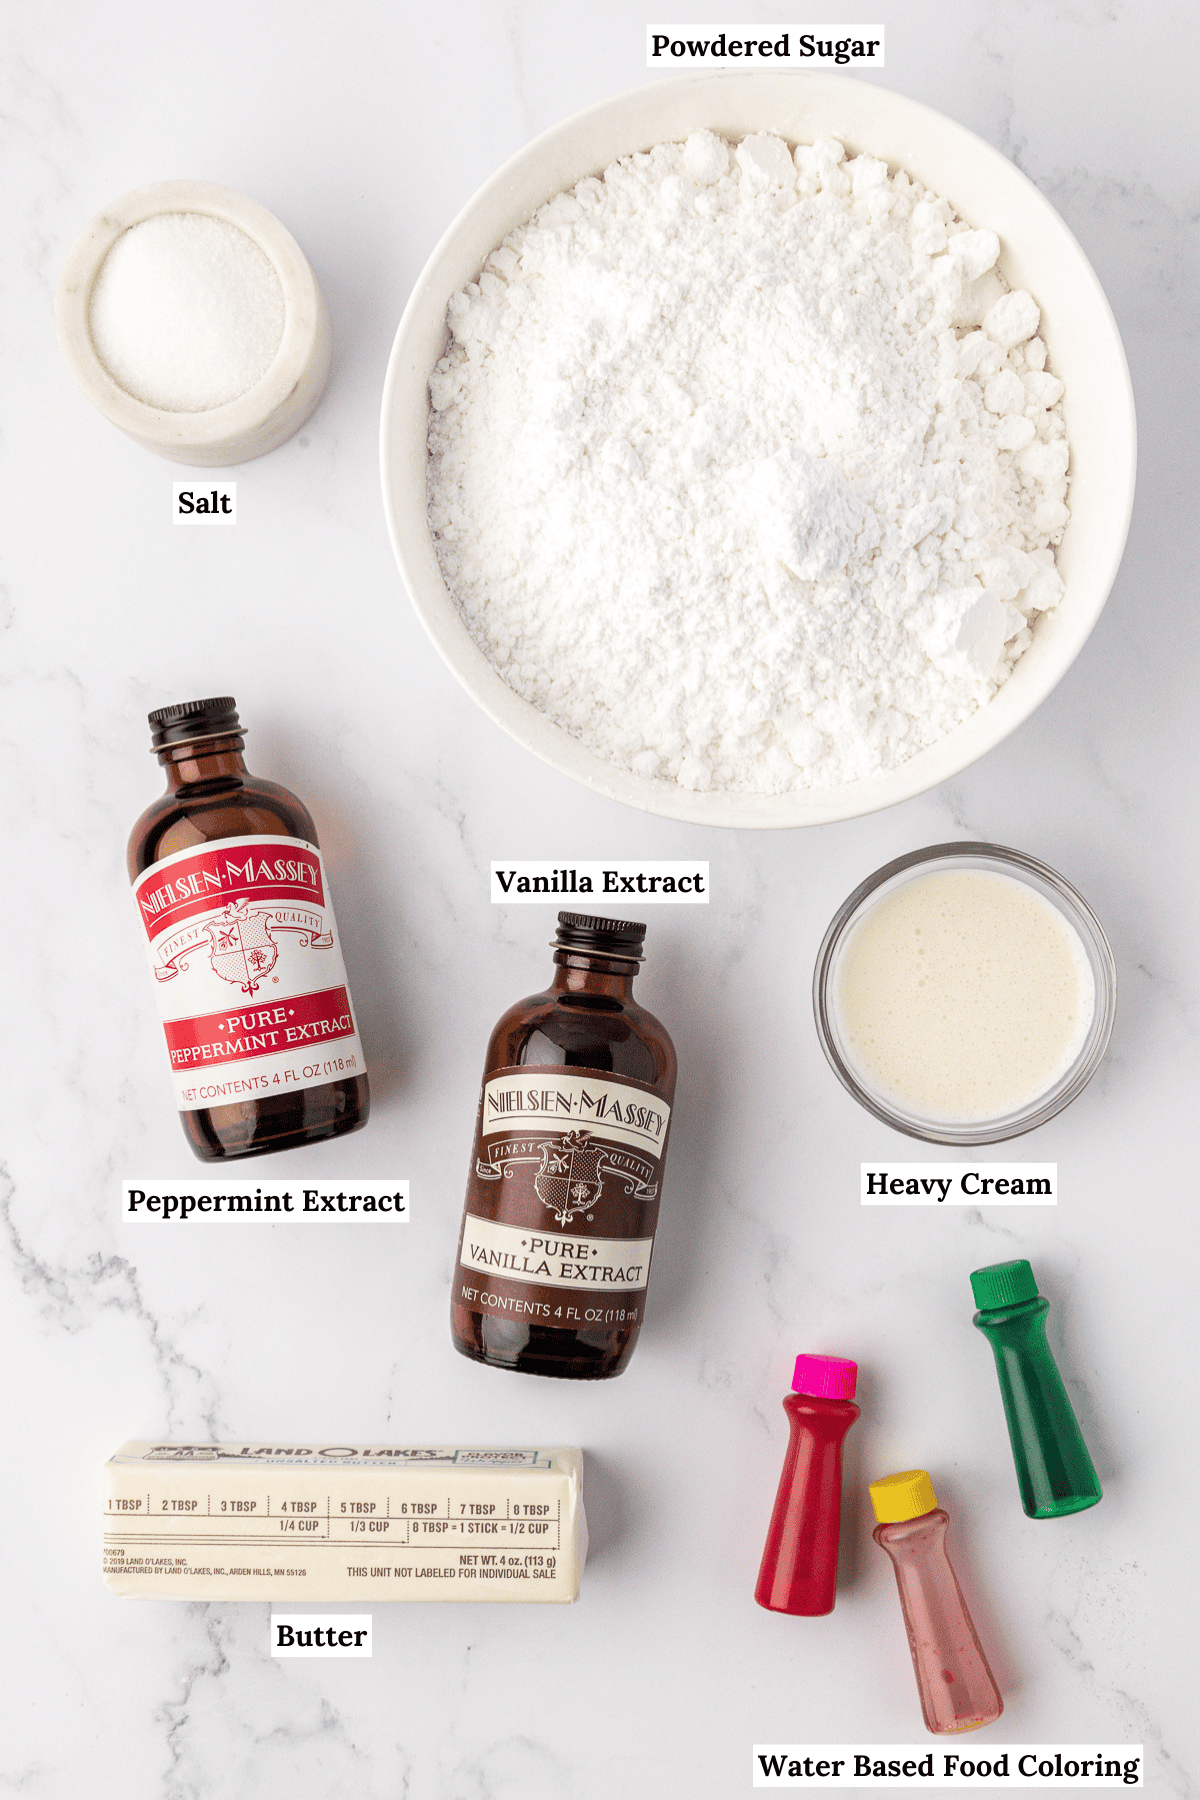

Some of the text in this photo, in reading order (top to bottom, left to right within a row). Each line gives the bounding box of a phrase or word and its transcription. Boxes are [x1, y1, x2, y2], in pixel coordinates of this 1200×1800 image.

[275, 912, 320, 928] QUALITY
[164, 928, 199, 957] FINEST
[226, 1007, 287, 1034] PURE
[170, 1014, 353, 1064] PEPPERMINT EXTRACT
[182, 1088, 197, 1101] NET
[199, 1074, 269, 1099] CONTENTS
[272, 1073, 281, 1085] 4
[284, 1069, 300, 1083] FL
[302, 1063, 322, 1078] OZ
[323, 1059, 345, 1076] (118
[494, 1142, 536, 1158] FINEST
[609, 1153, 651, 1178] QUALITY
[529, 1238, 589, 1260] PURE
[470, 1243, 643, 1283] VANILLA EXTRACT
[461, 1285, 478, 1301] NET
[480, 1291, 551, 1318] CONTENTS
[554, 1306, 563, 1319] 4
[566, 1307, 580, 1320] FL
[584, 1308, 604, 1322] OZ
[605, 1307, 626, 1324] (118
[240, 1447, 313, 1456] LAND
[362, 1449, 437, 1457] LAKES
[116, 1500, 142, 1510] TBSP
[162, 1500, 198, 1511] 2 TBSP
[221, 1501, 257, 1512] 3 TBSP
[281, 1501, 317, 1513] 4 TBSP
[340, 1503, 376, 1514] 5 TBSP
[401, 1503, 438, 1514] 6 TBSP
[460, 1504, 496, 1515] 7 TBSP
[513, 1505, 550, 1516] 8 TBSP
[279, 1520, 319, 1531] 1/4 CUP
[350, 1521, 390, 1532] 1/3 CUP
[413, 1522, 419, 1533] 8
[423, 1522, 449, 1533] TBSP
[460, 1522, 465, 1533] 1
[467, 1522, 498, 1534] STICK
[509, 1523, 525, 1534] 1/2
[528, 1523, 549, 1534] CUP
[459, 1555, 556, 1568] NET WT. 4 oz. (113 g)
[164, 1567, 182, 1575] LAND
[229, 1568, 251, 1576] ARDEN
[253, 1568, 273, 1577] HILLS,
[347, 1567, 556, 1579] THIS UNIT NOT LABELED FOR INDIVIDUAL SALE
